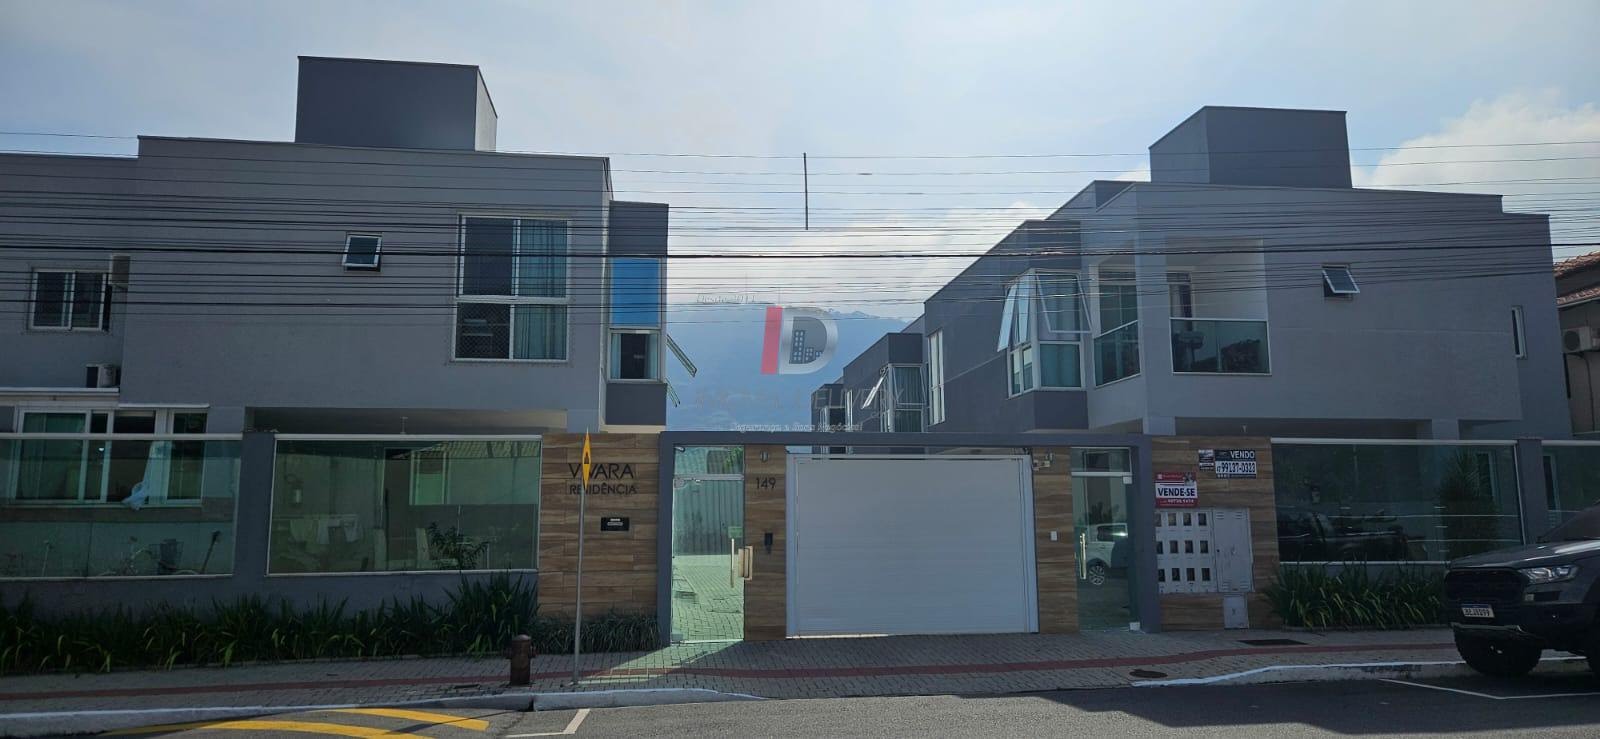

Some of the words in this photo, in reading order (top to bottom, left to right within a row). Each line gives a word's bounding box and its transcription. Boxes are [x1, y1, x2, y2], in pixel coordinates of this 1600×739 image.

[1230, 451, 1255, 459] VENDO
[568, 463, 634, 479] VVARA
[755, 476, 777, 489] 149
[1157, 487, 1196, 497] VENDE-SE
